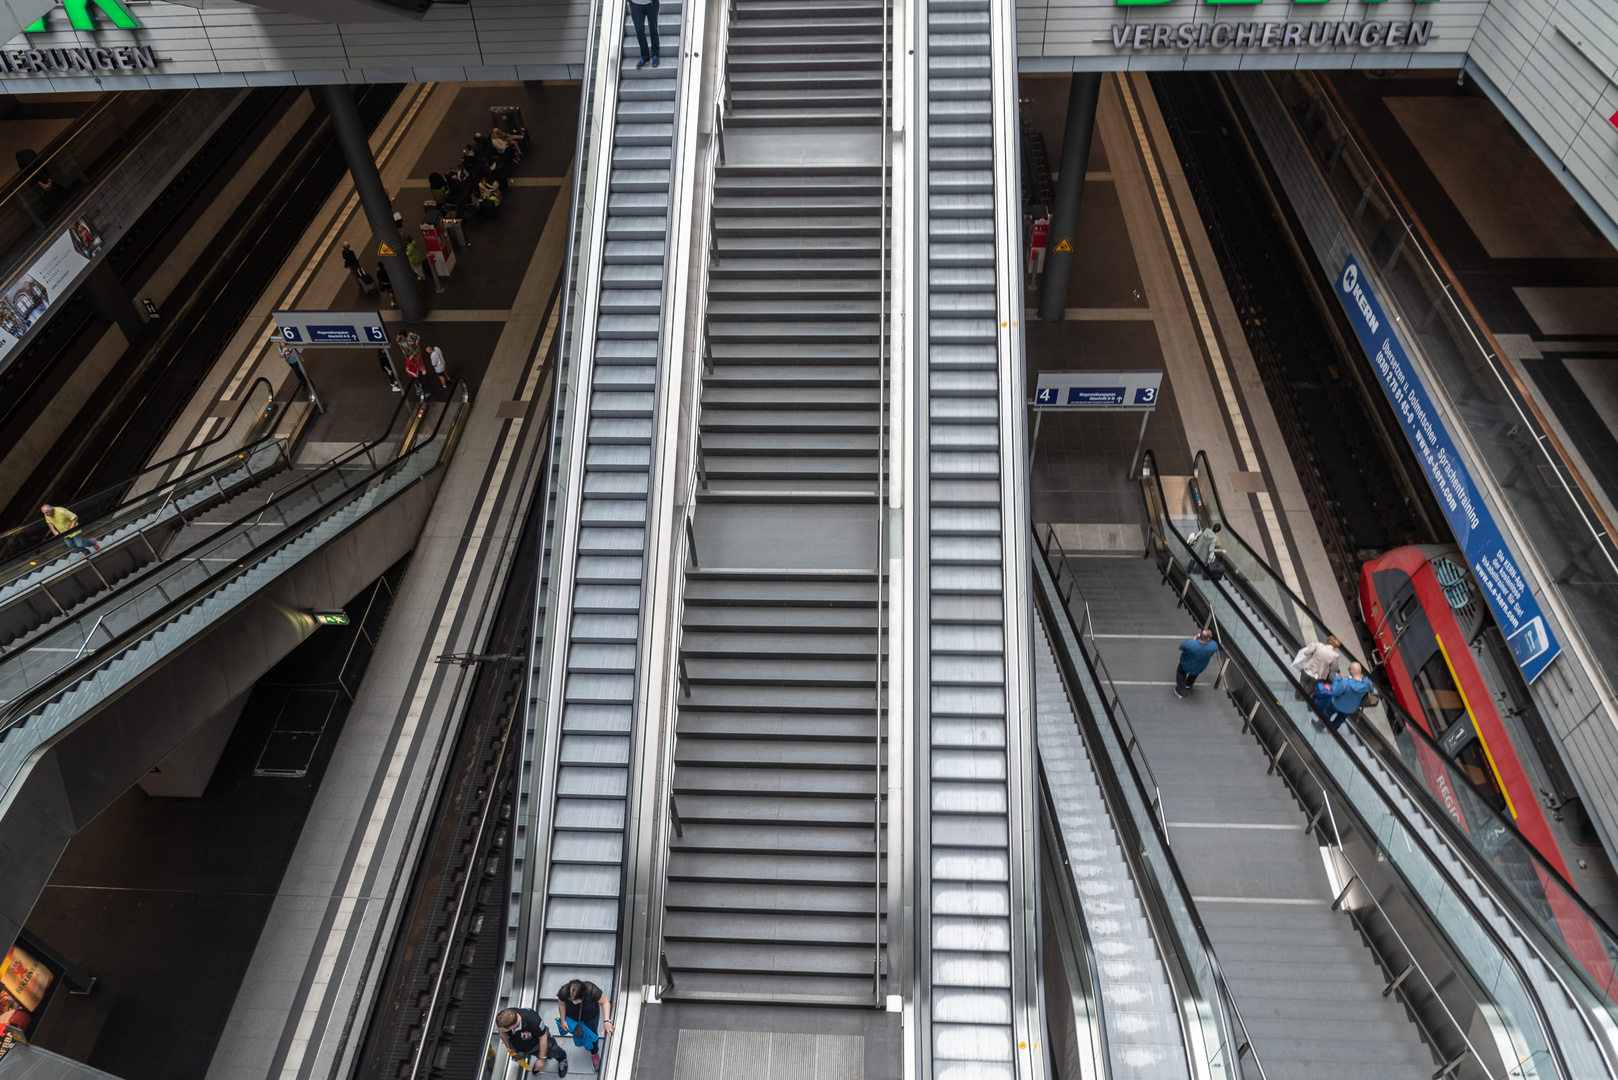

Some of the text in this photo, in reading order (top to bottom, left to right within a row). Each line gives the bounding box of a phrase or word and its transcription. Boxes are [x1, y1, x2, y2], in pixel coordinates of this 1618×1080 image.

[1111, 20, 1433, 50] VERSICHERUNGEN
[1353, 283, 1379, 334] KERN
[283, 327, 382, 339] 6 5
[1040, 388, 1154, 401] 4 3
[1376, 351, 1390, 376] (030)
[1416, 430, 1457, 512] www.e-kern.com
[1382, 338, 1405, 384] Übersetzen
[1402, 382, 1408, 393] u.
[1408, 390, 1436, 445] Dolmetschen
[1438, 448, 1479, 529] Sprachentraining
[1482, 555, 1508, 595] Vokabeltrainer
[1499, 567, 1520, 599] kostenlose
[1504, 559, 1524, 592] KERN-App,
[1476, 563, 1518, 628] www.m.e-kern.com
[1456, 728, 1464, 739] 1
